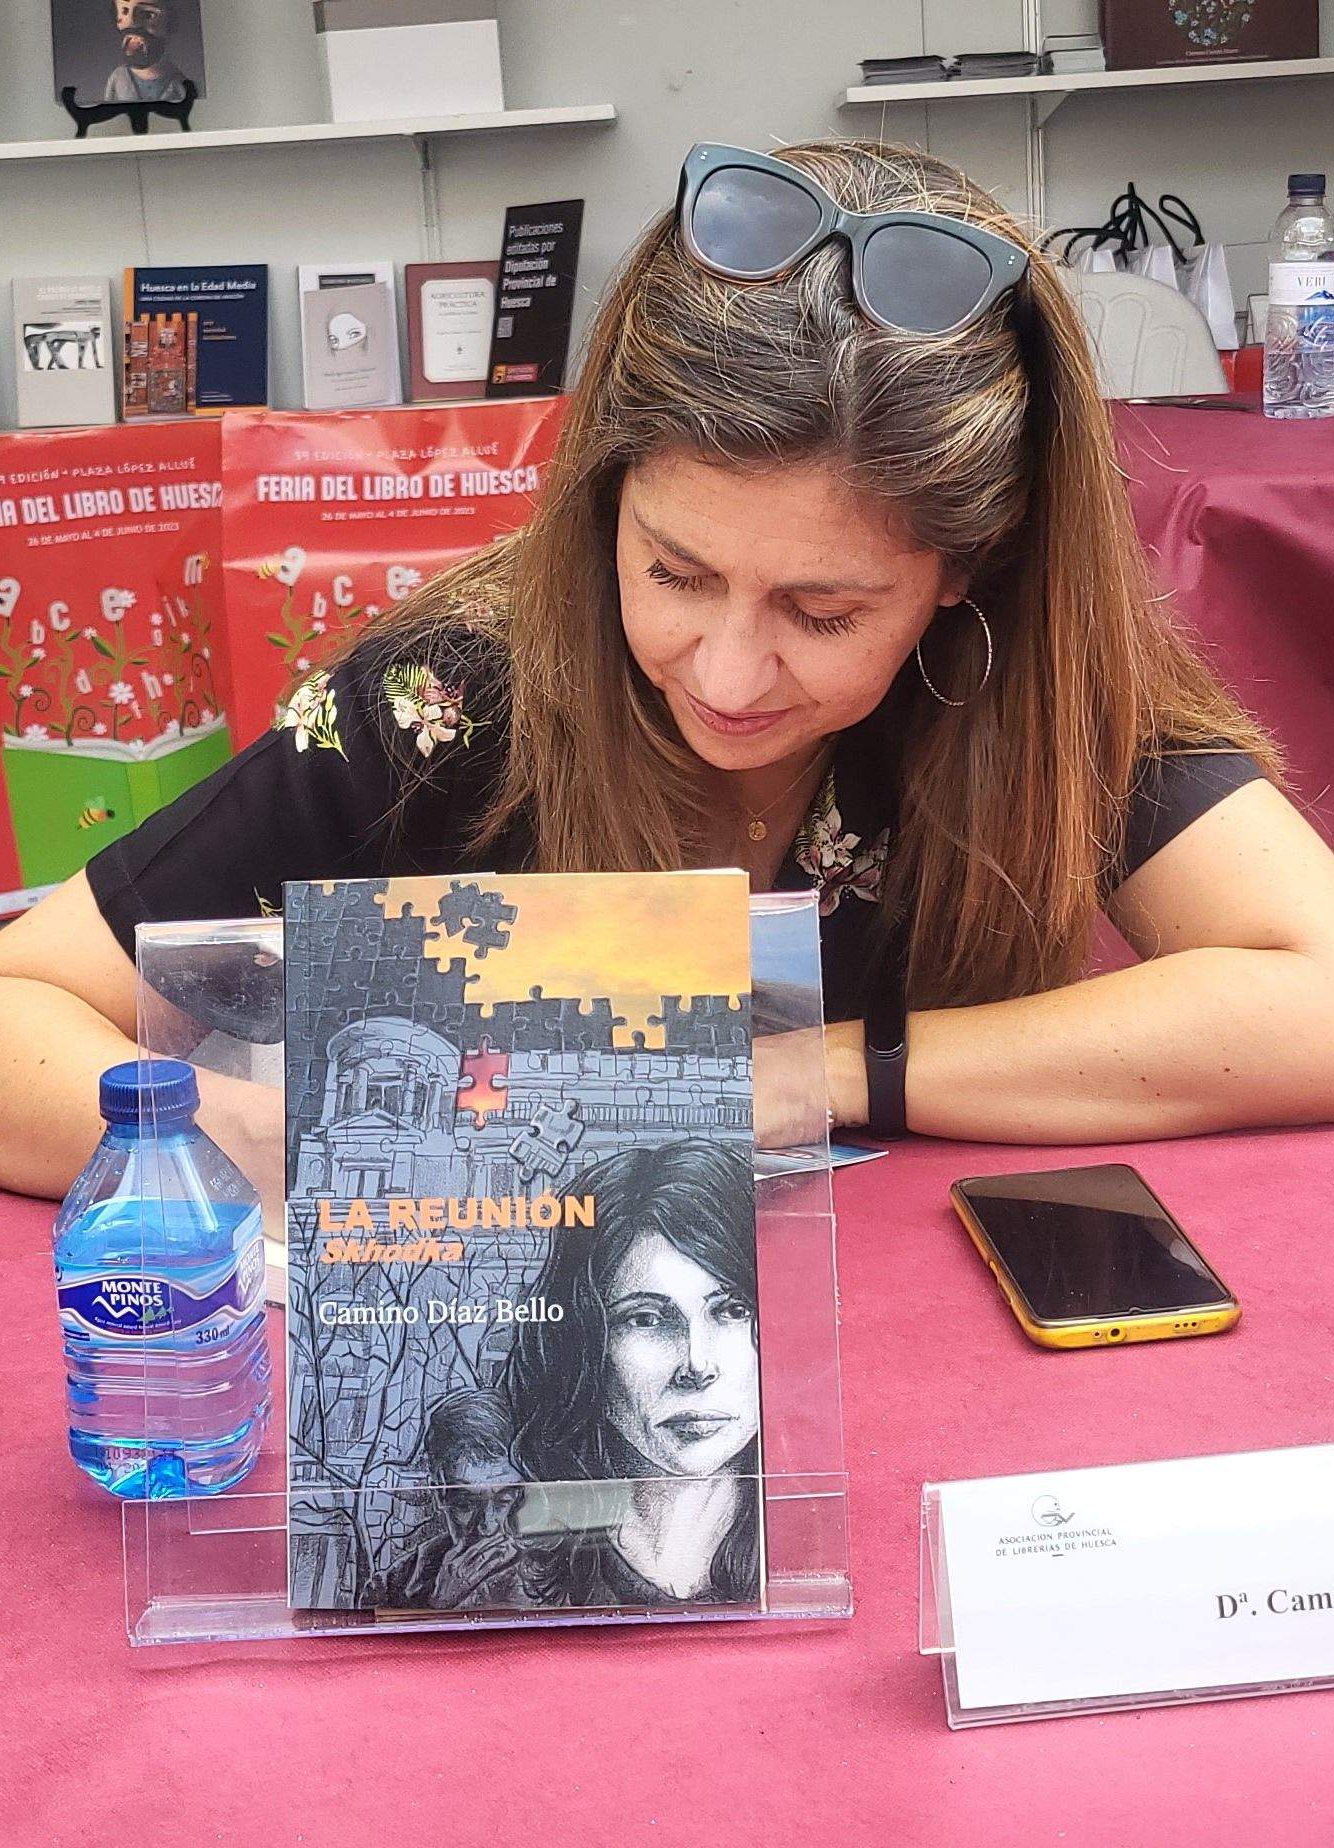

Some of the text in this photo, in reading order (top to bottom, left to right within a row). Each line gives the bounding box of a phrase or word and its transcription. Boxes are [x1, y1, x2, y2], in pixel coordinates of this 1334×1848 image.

[509, 222, 563, 237] Publicaciones
[506, 241, 556, 255] editadas por
[505, 258, 549, 273] Diputación
[141, 282, 175, 292] Huesca
[191, 283, 199, 291] la
[201, 281, 224, 291] Edad
[227, 281, 256, 290] Media
[503, 275, 556, 291] Provincial de
[501, 296, 531, 309] Huesca
[10, 469, 58, 484] EDICIÓN
[72, 466, 113, 477] PLAZA
[117, 461, 154, 473] LÓPEZ
[159, 457, 195, 471] ALLUÉ
[258, 466, 537, 501] FERIA DEL LIBRO DE HUESCA
[21, 495, 59, 525] DEL
[64, 489, 124, 519] LIBRO
[129, 486, 156, 513] DE
[160, 482, 222, 509] HUESC
[28, 537, 39, 547] 26
[41, 535, 52, 545] DE
[54, 533, 79, 544] MAYO
[81, 532, 92, 540] AL
[102, 529, 113, 538] DE
[116, 526, 143, 536] JUNIO
[145, 524, 156, 534] DE
[158, 522, 179, 532] 2023
[319, 1188, 595, 1231] LA REUNIÓN
[102, 1281, 162, 1293] MONTE
[111, 1294, 163, 1306] PINOS
[319, 1297, 563, 1325] Camino Díaz Bello
[196, 1329, 218, 1345] 330
[1065, 1542, 1076, 1550] DE
[1082, 1539, 1116, 1548] HUESCA
